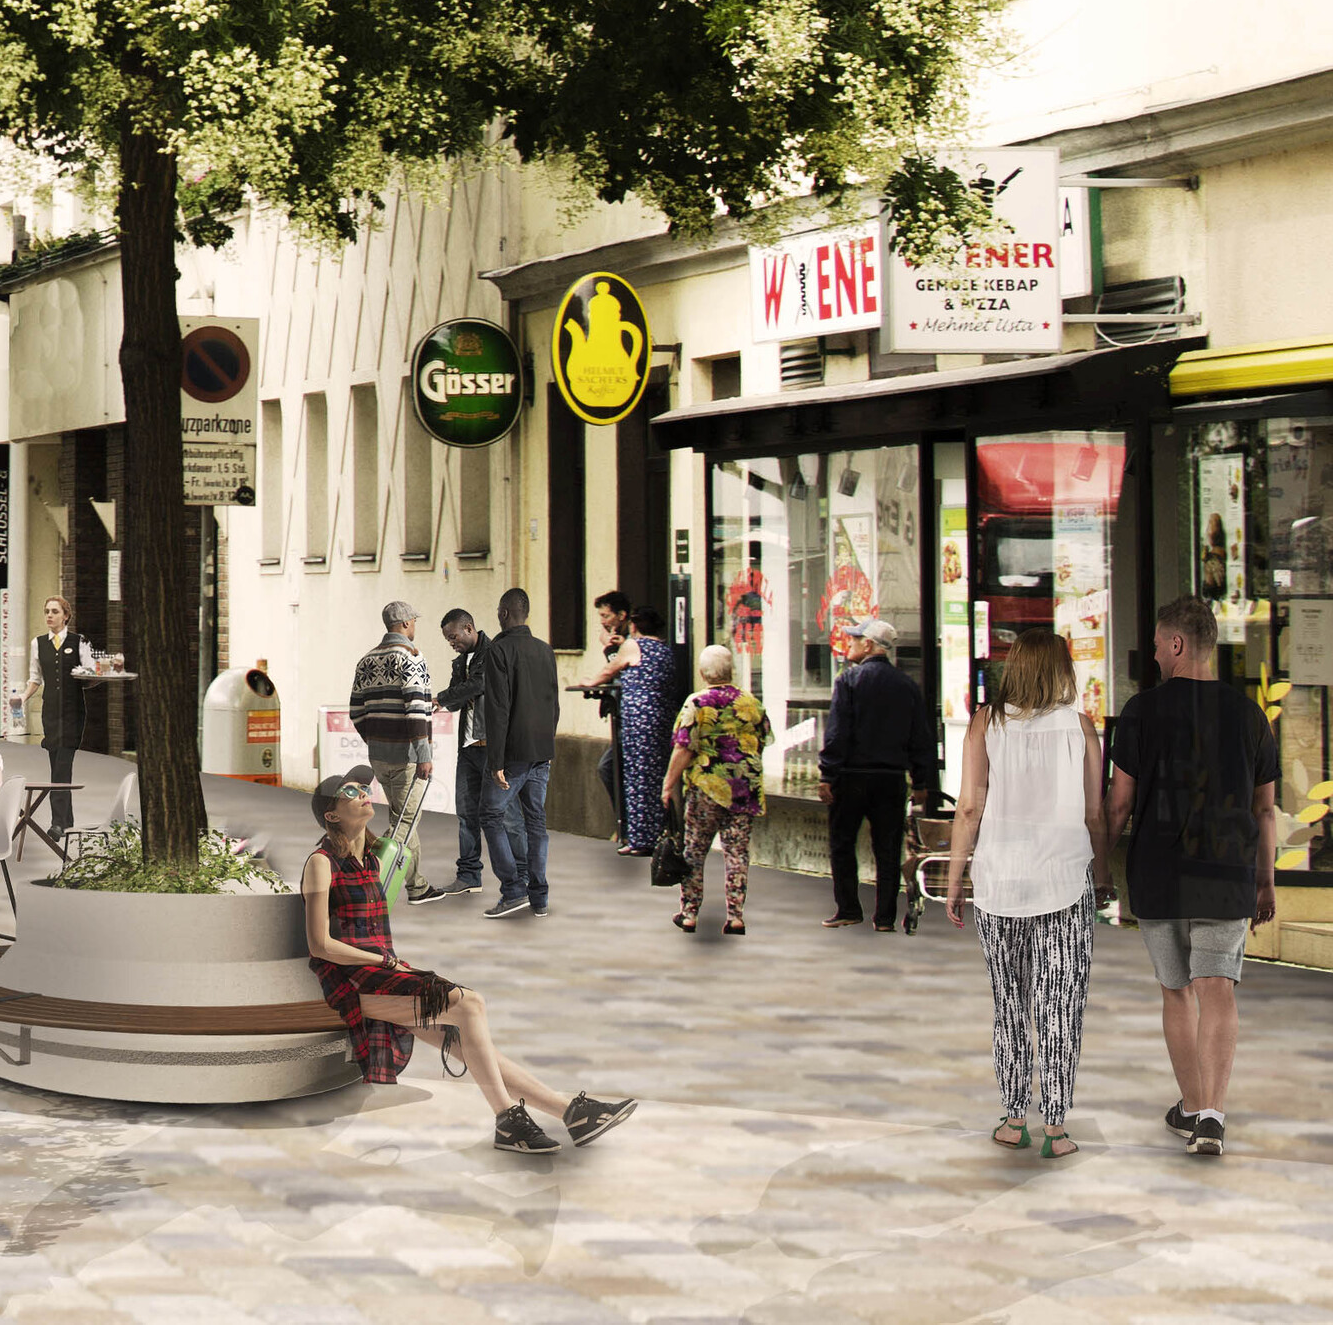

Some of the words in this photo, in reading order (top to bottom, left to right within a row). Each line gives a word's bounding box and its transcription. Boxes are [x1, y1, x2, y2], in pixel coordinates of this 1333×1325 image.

[984, 279, 1039, 292] KEBAP
[944, 298, 954, 311] &
[922, 317, 991, 333] Mehmet
[420, 359, 516, 404] Gösser
[181, 413, 252, 436] urzparkzone
